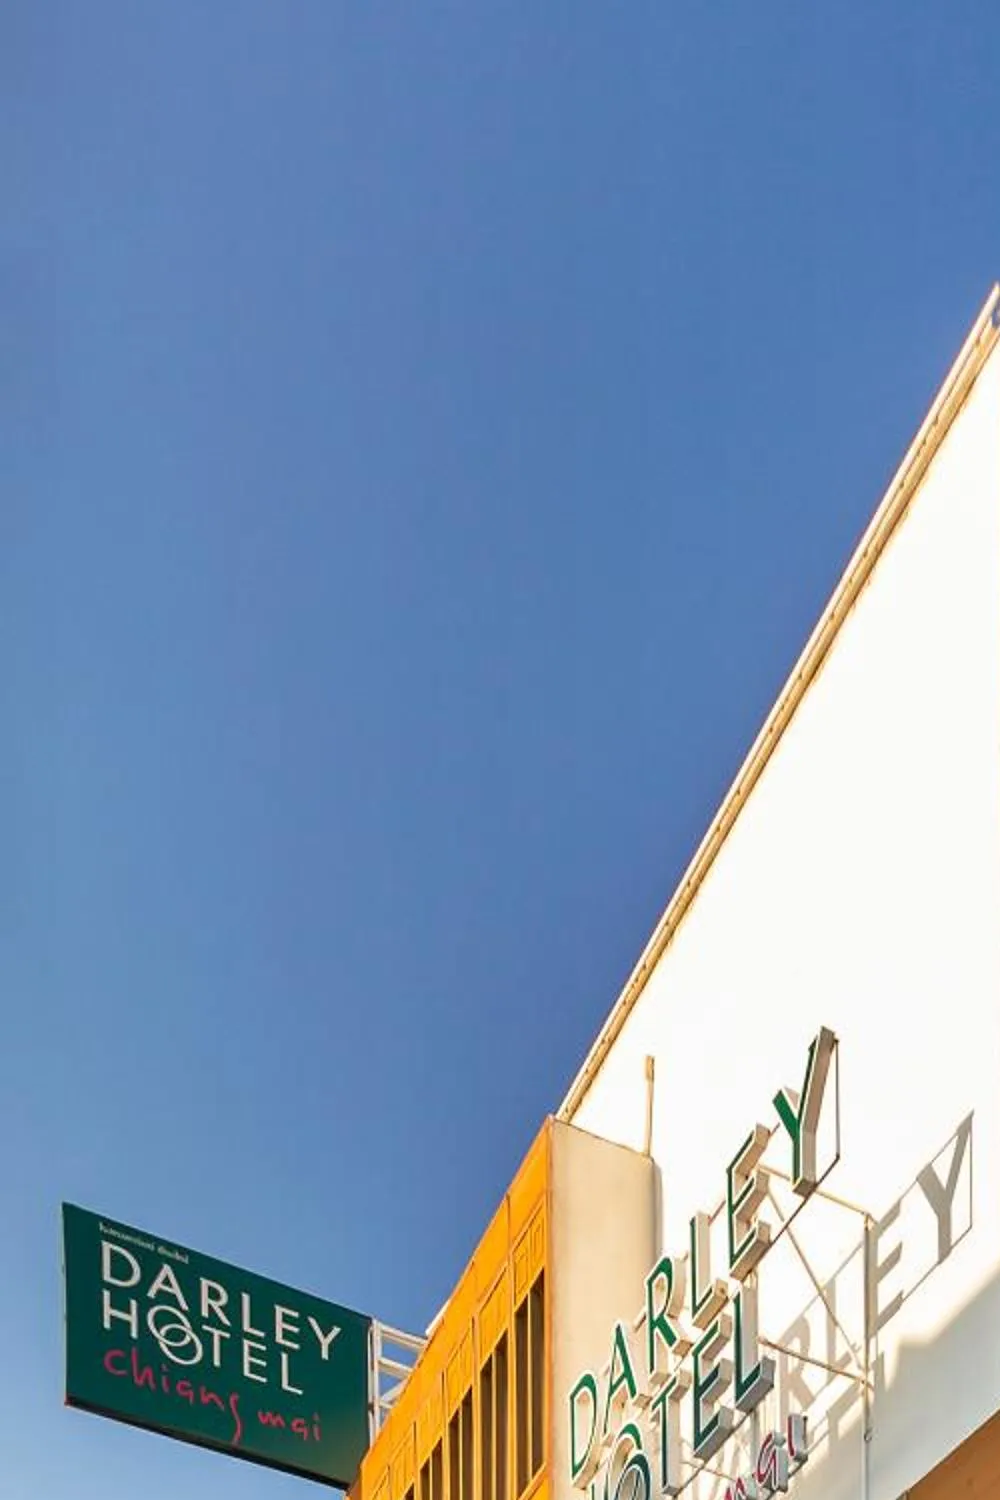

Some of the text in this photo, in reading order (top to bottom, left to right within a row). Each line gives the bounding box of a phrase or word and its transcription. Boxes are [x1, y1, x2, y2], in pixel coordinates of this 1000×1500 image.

[101, 1240, 341, 1360] DARLEY
[569, 1027, 834, 1489] DARLEY
[102, 1290, 304, 1395] HOTEL
[258, 1409, 322, 1441] mai
